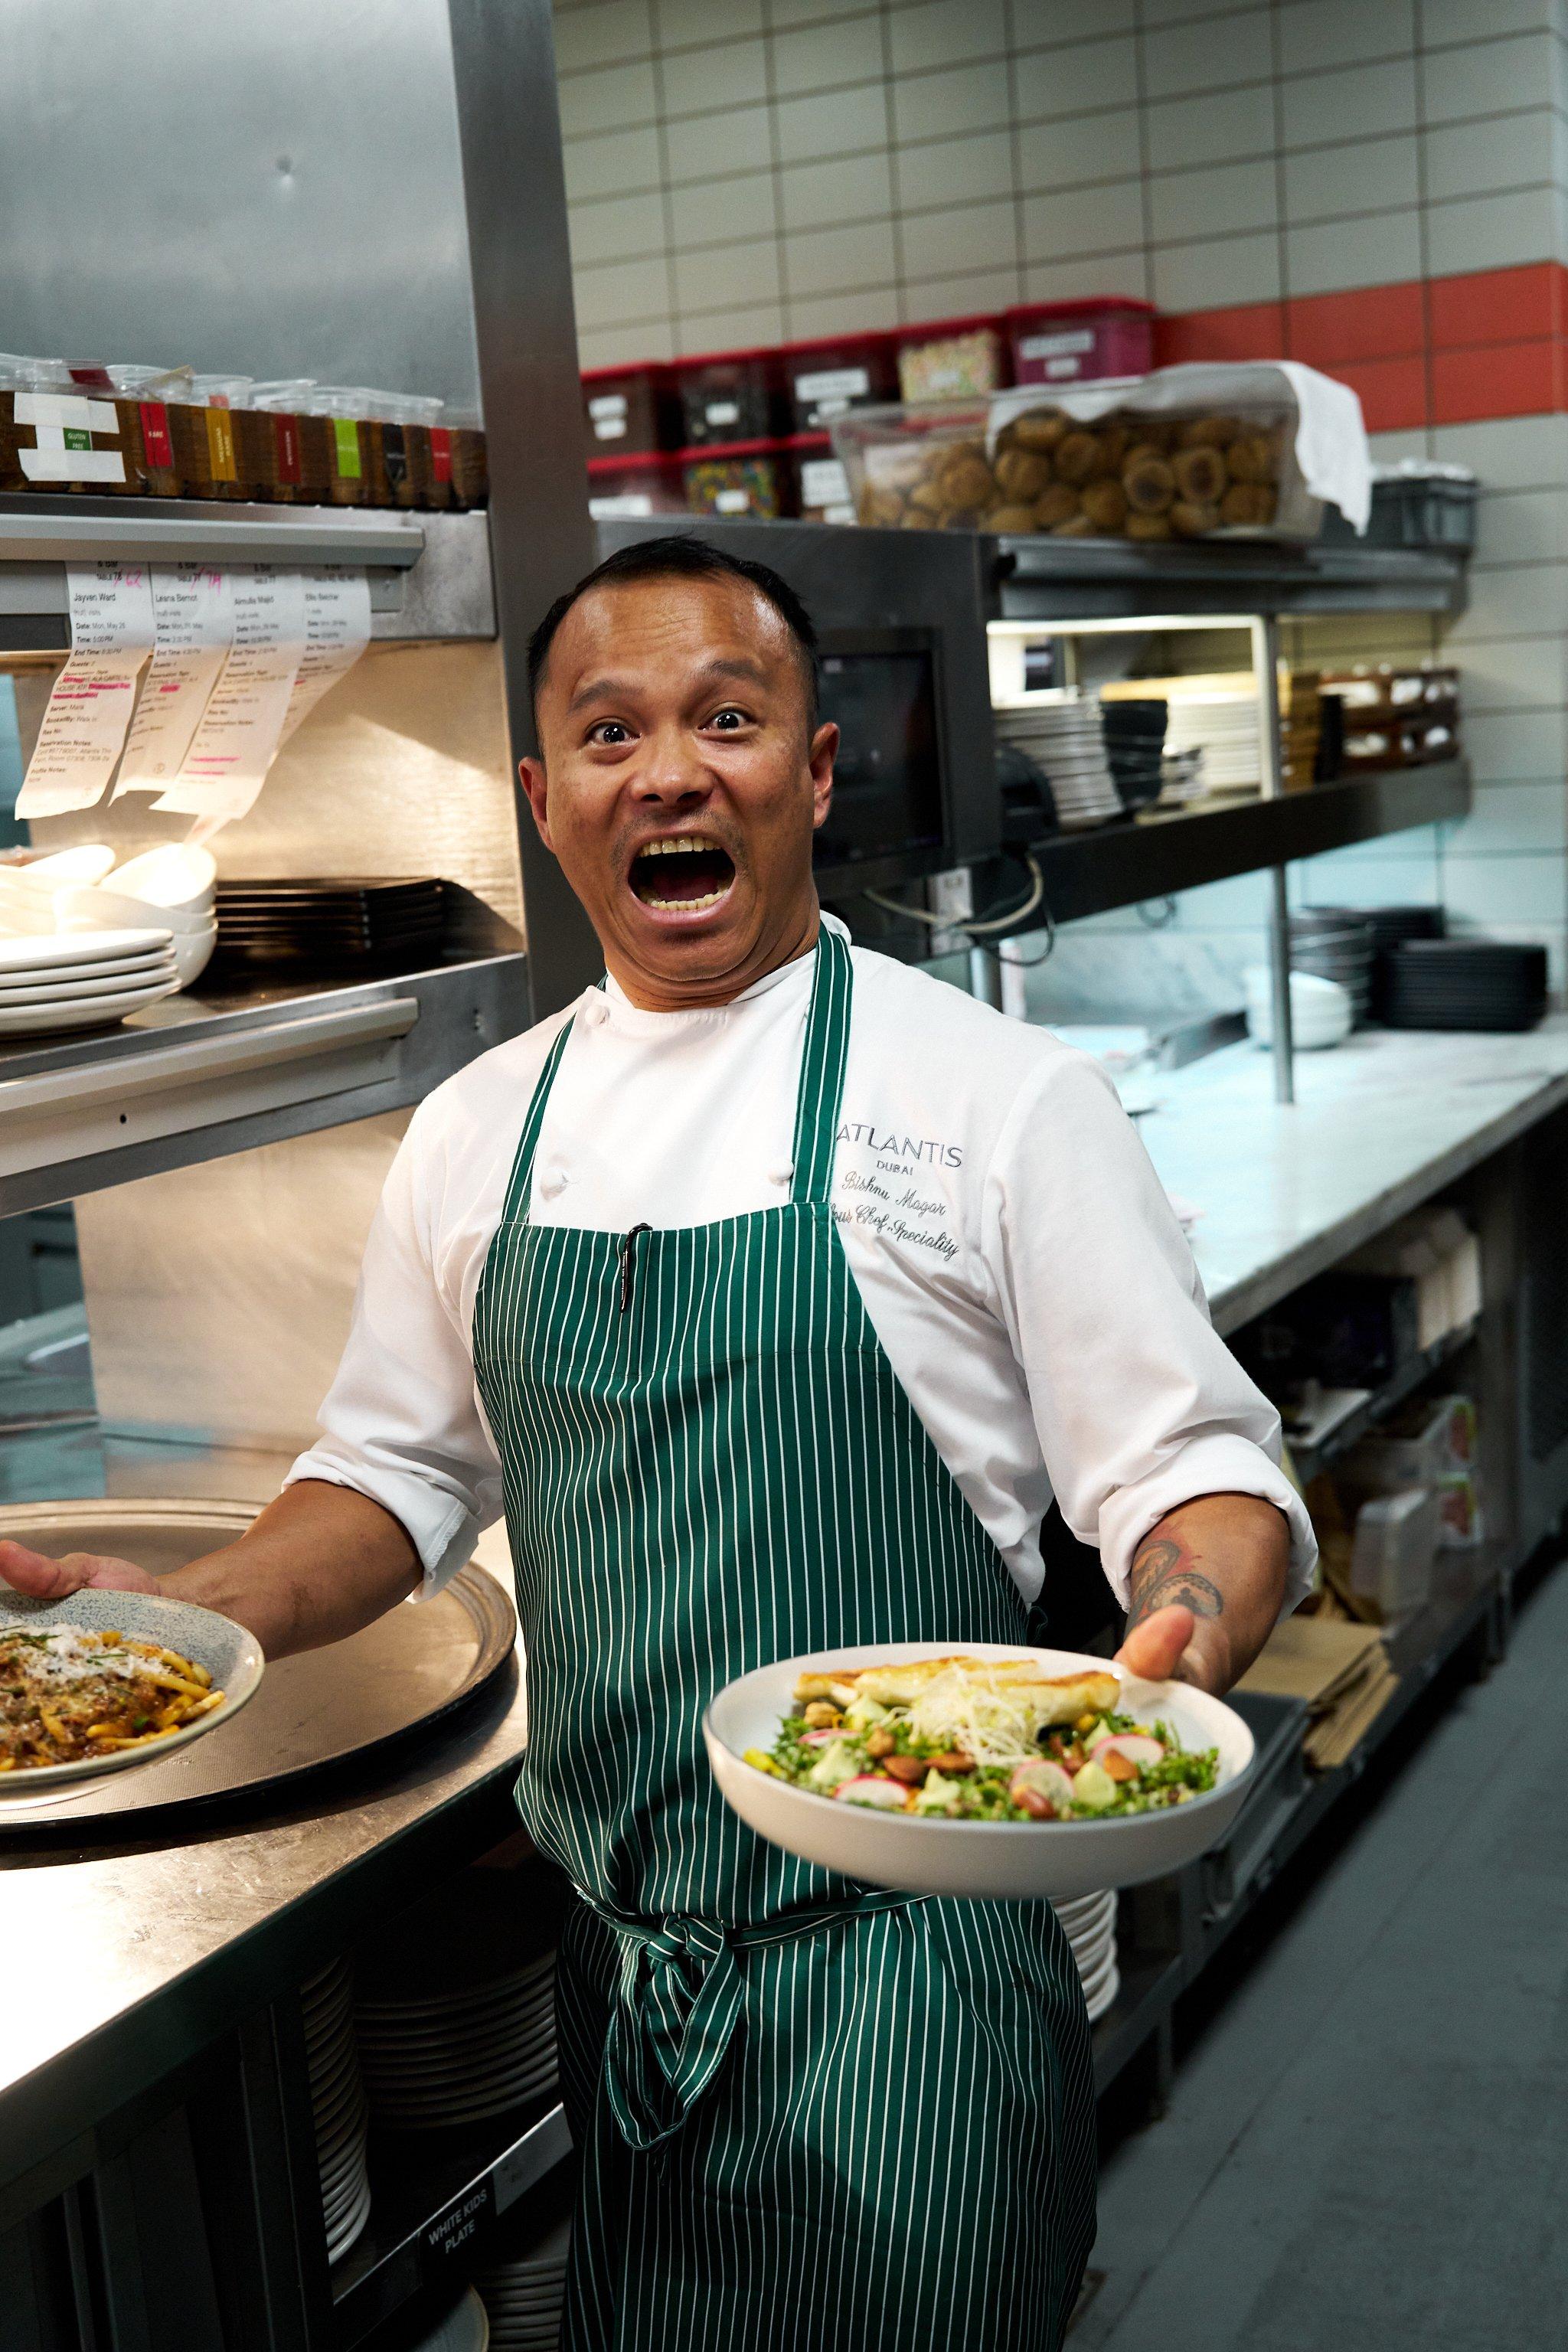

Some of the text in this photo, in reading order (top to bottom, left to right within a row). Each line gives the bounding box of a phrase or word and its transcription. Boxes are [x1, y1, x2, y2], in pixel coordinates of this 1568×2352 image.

[67, 432, 87, 441] GLUTEN
[99, 593, 116, 602] Ward
[836, 1122, 963, 1168] ATLANTIS
[877, 1160, 914, 1176] DUBAI
[841, 1171, 947, 1219] Bishnu Magar
[855, 1204, 890, 1234] Chef
[428, 2188, 488, 2246] WHITE KIDS
[444, 2219, 476, 2255] PLATE
